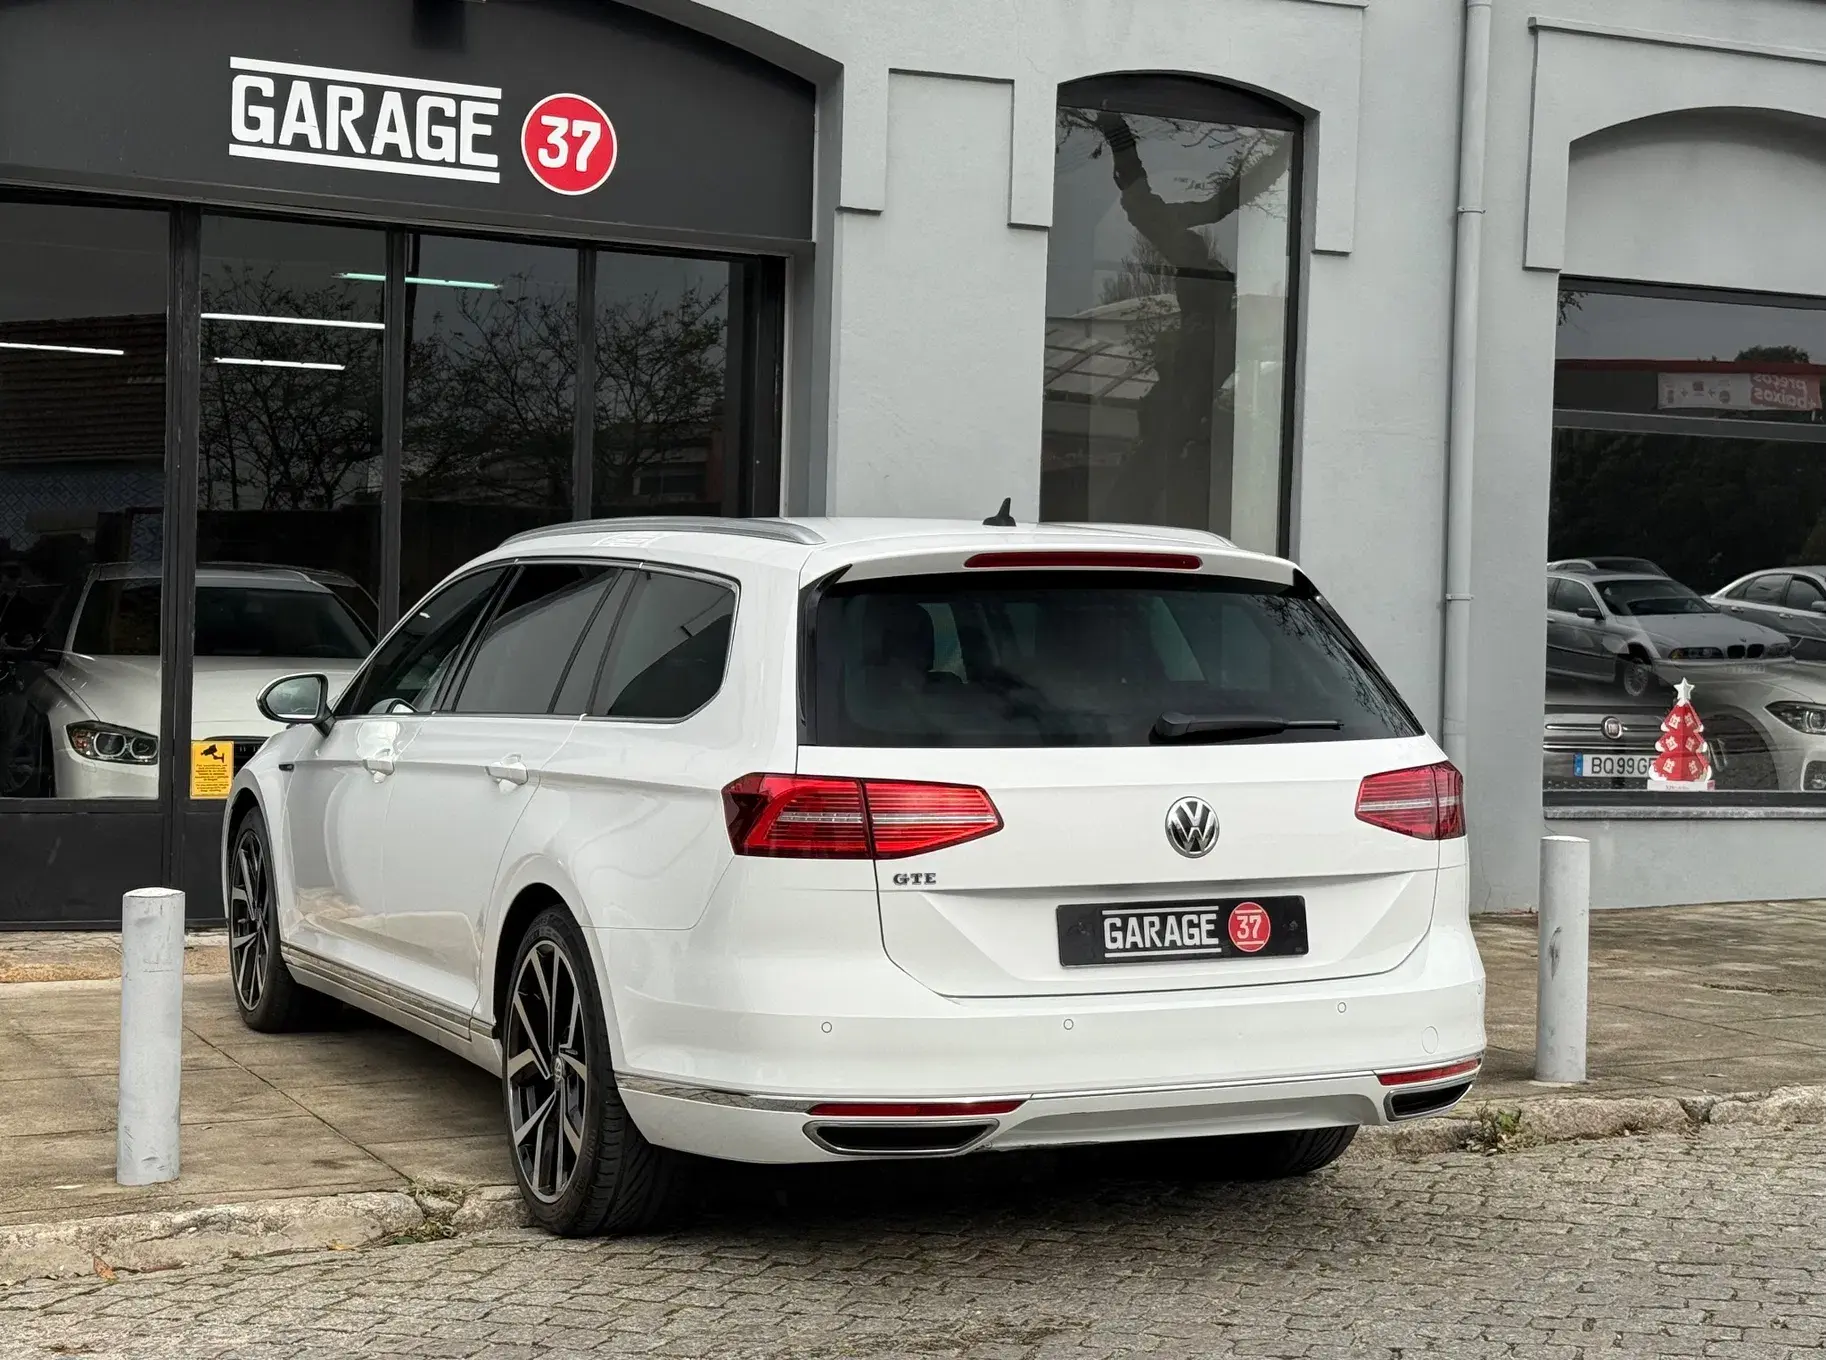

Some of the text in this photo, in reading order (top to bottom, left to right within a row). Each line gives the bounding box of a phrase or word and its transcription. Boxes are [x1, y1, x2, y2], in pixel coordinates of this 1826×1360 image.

[231, 74, 602, 173] GARAGE 37
[1591, 756, 1614, 774] BQ
[1616, 756, 1635, 774] 99
[893, 872, 937, 886] GTE
[1103, 913, 1262, 950] GARAGE 37
